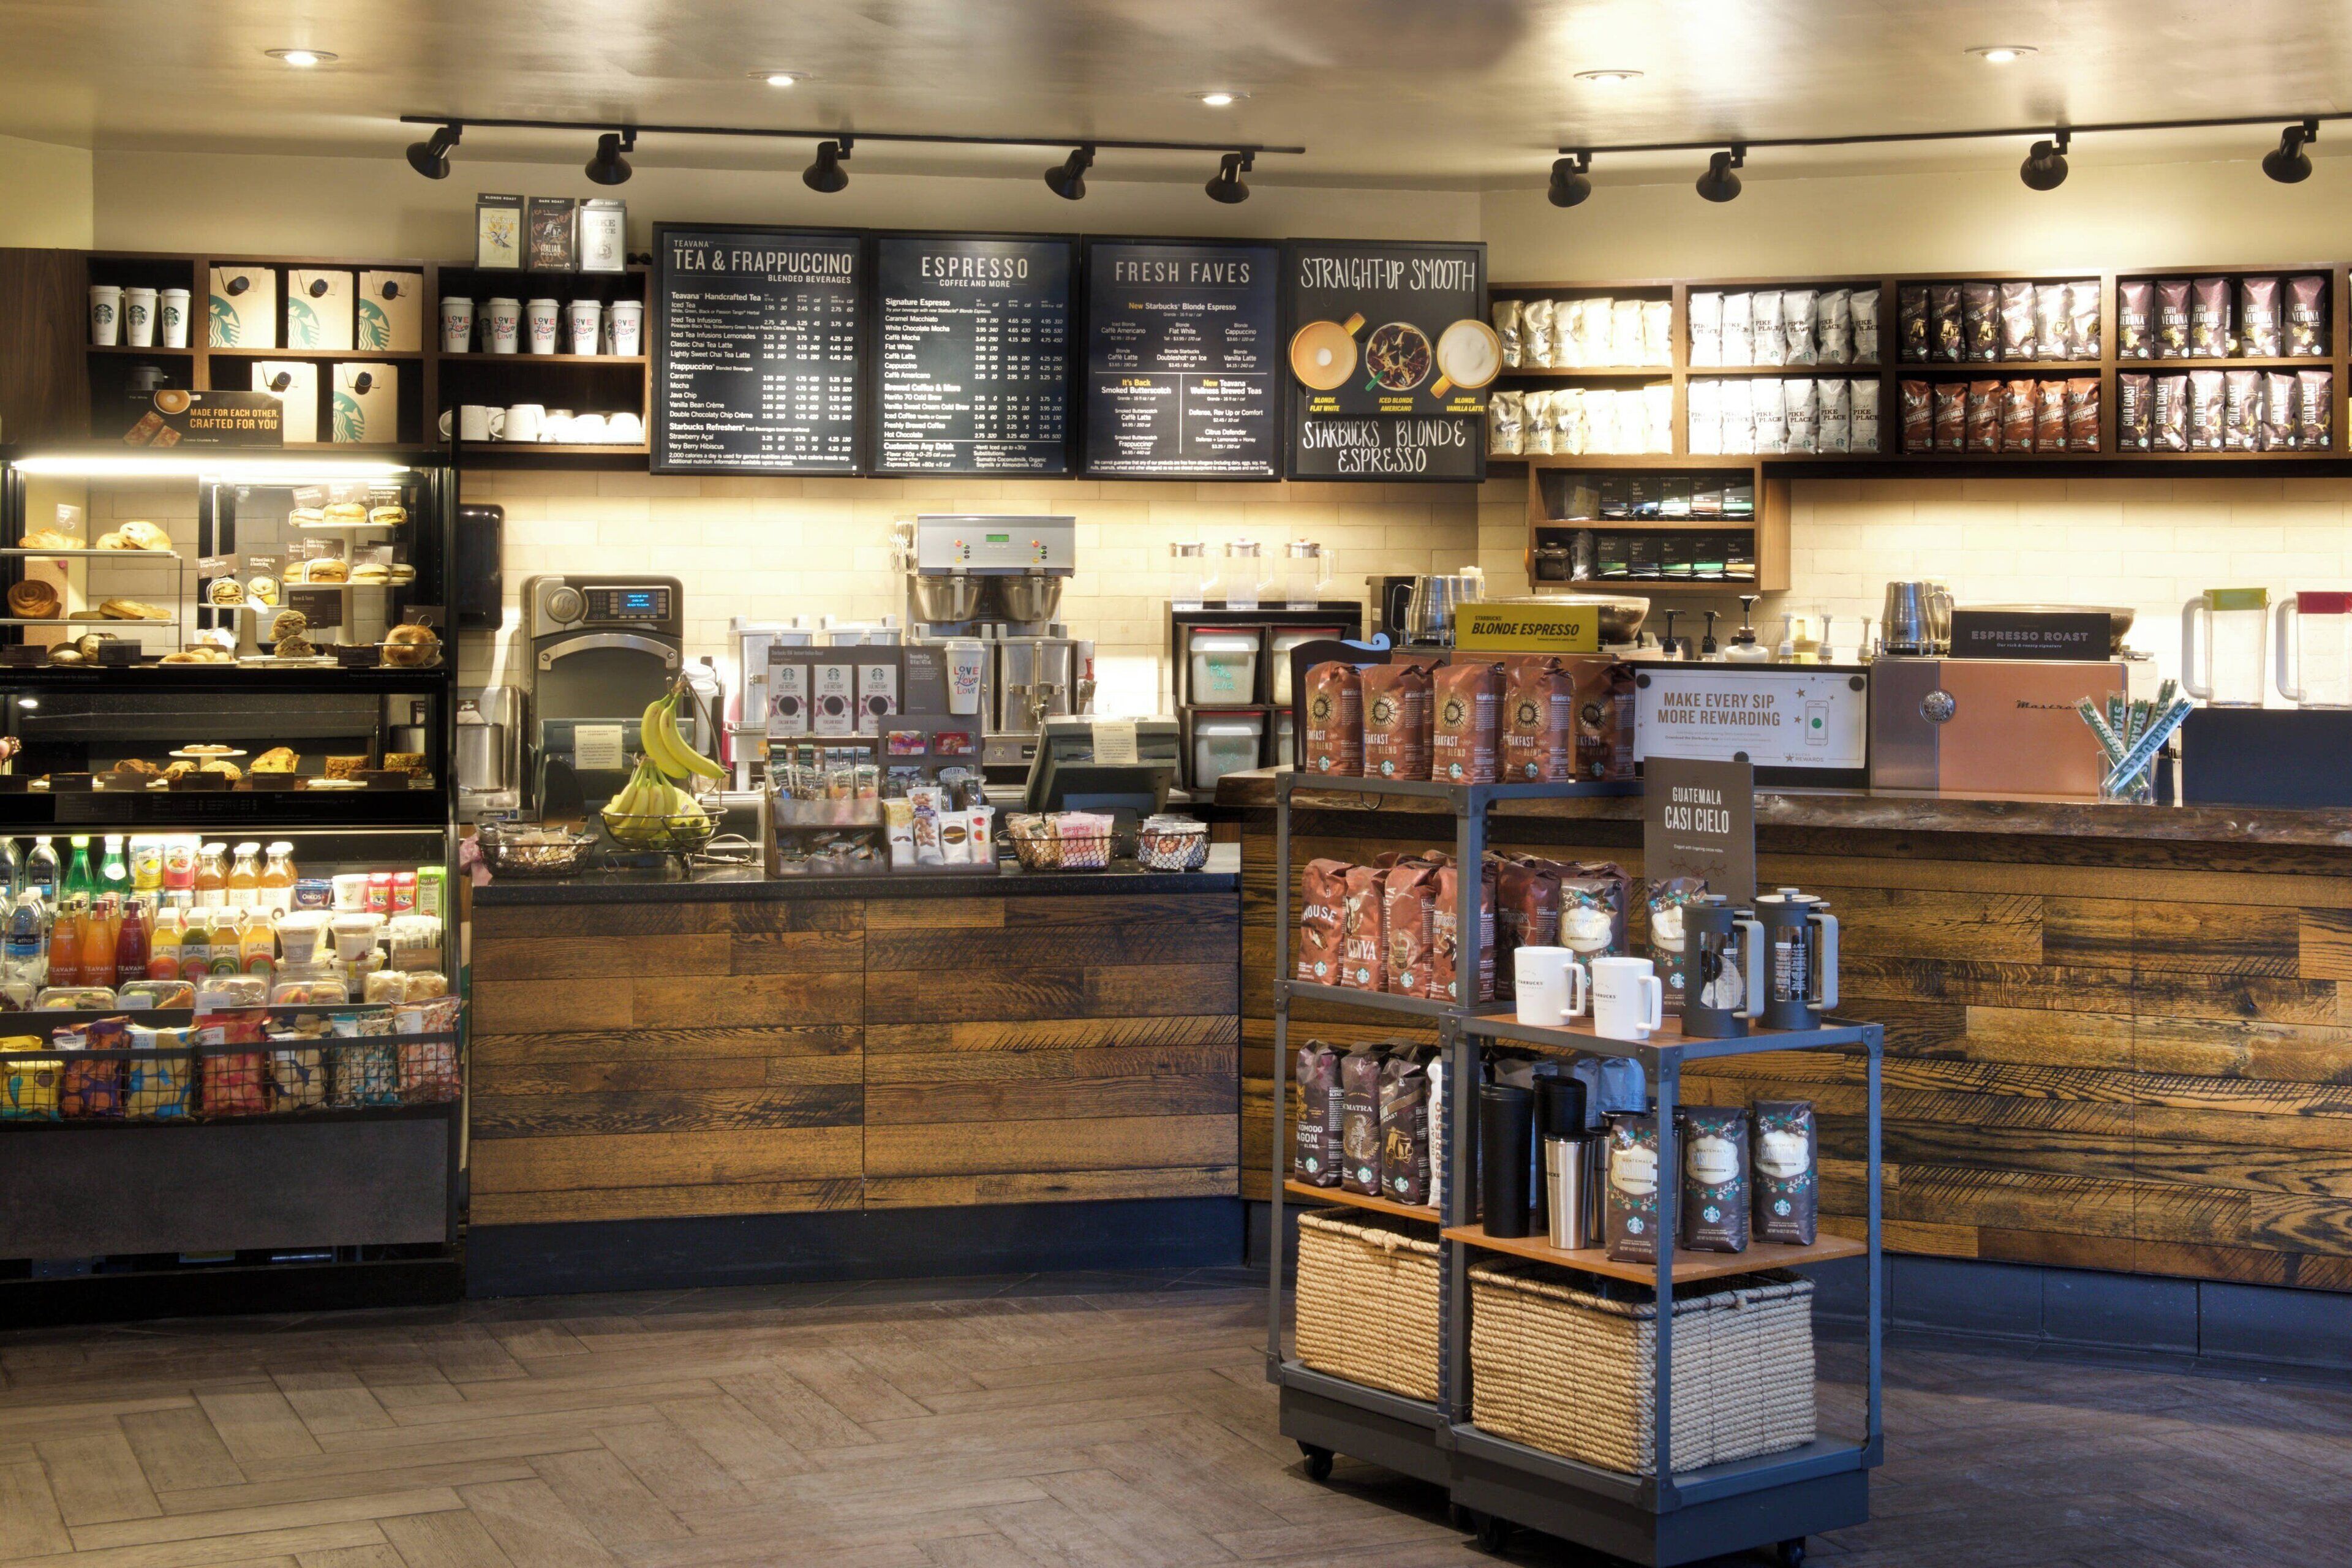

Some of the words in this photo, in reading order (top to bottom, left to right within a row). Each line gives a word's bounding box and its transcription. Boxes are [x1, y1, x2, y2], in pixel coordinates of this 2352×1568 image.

[674, 250, 706, 270] TEA
[712, 251, 725, 270] &
[732, 252, 852, 274] FRAPPUCCINO
[922, 257, 1028, 278] ESPRESSO
[1116, 262, 1179, 282] FRESH
[1191, 263, 1250, 283] FAVES
[1301, 258, 1404, 290] STRAIGHT-UP
[1410, 259, 1475, 292] SMOOTH
[190, 419, 233, 429] CRAFTED
[236, 420, 255, 429] FOR
[258, 420, 277, 429] YOU
[1303, 421, 1380, 448] STARBUCKS
[1396, 419, 1465, 447] BLONDE
[1338, 448, 1426, 472] ESPRESSO
[1472, 623, 1518, 635] BLONDE
[1520, 624, 1579, 635] ESPRESSO
[1972, 631, 2038, 641] ESPRESSO
[2045, 632, 2088, 641] ROAST
[954, 666, 979, 675] LOVE
[954, 674, 978, 686] Love
[1664, 693, 1701, 707] MAKE
[1706, 694, 1748, 708] EVERY
[1753, 694, 1774, 709] SIP
[1658, 709, 1695, 724] MORE
[1700, 710, 1780, 726] REWARDING
[1673, 787, 1721, 805] GUATEMALA
[1665, 805, 1691, 830] CASI
[1695, 809, 1728, 833] CIELO
[1304, 905, 1337, 923] HOUSE
[1348, 939, 1376, 960] KENYA
[1297, 1133, 1317, 1142] AGON
